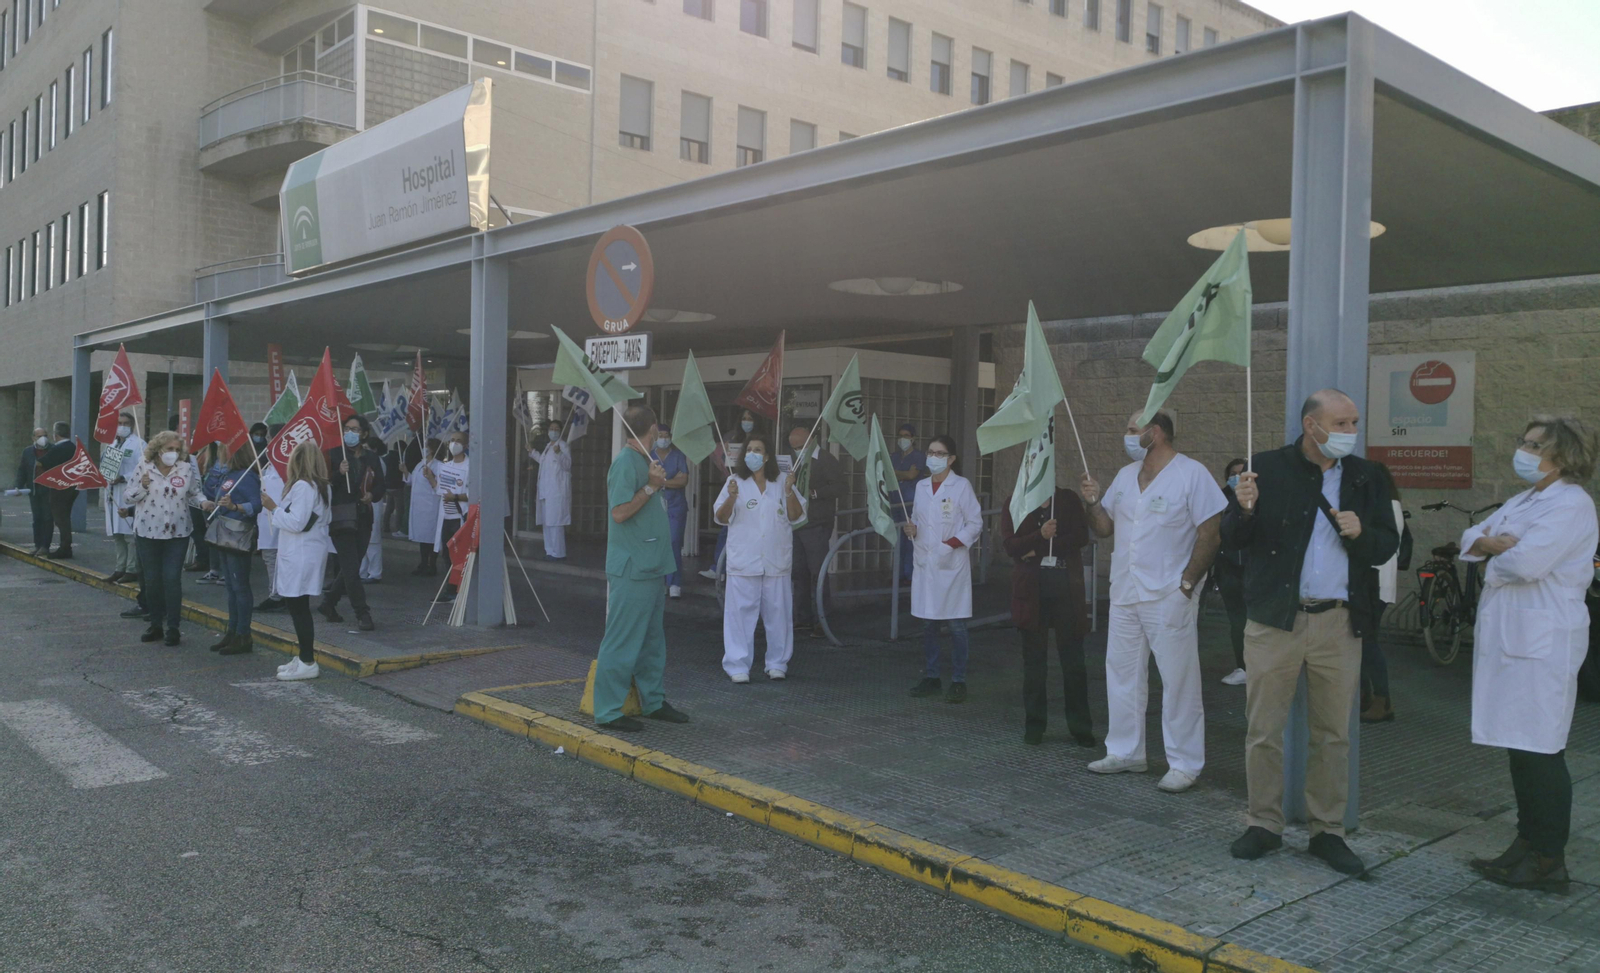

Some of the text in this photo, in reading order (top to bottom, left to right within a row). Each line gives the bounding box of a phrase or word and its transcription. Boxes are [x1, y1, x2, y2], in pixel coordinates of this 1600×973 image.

[402, 149, 456, 193] Hospital
[368, 190, 458, 230] Juan Ramón Jiménez
[603, 319, 629, 332] GRUA
[591, 338, 642, 364] EXCEPTO TAXIS
[1392, 414, 1432, 426] espacio
[1392, 426, 1407, 435] sin
[105, 448, 123, 461] SATSE
[1387, 449, 1448, 458] ¡RECUERDE!
